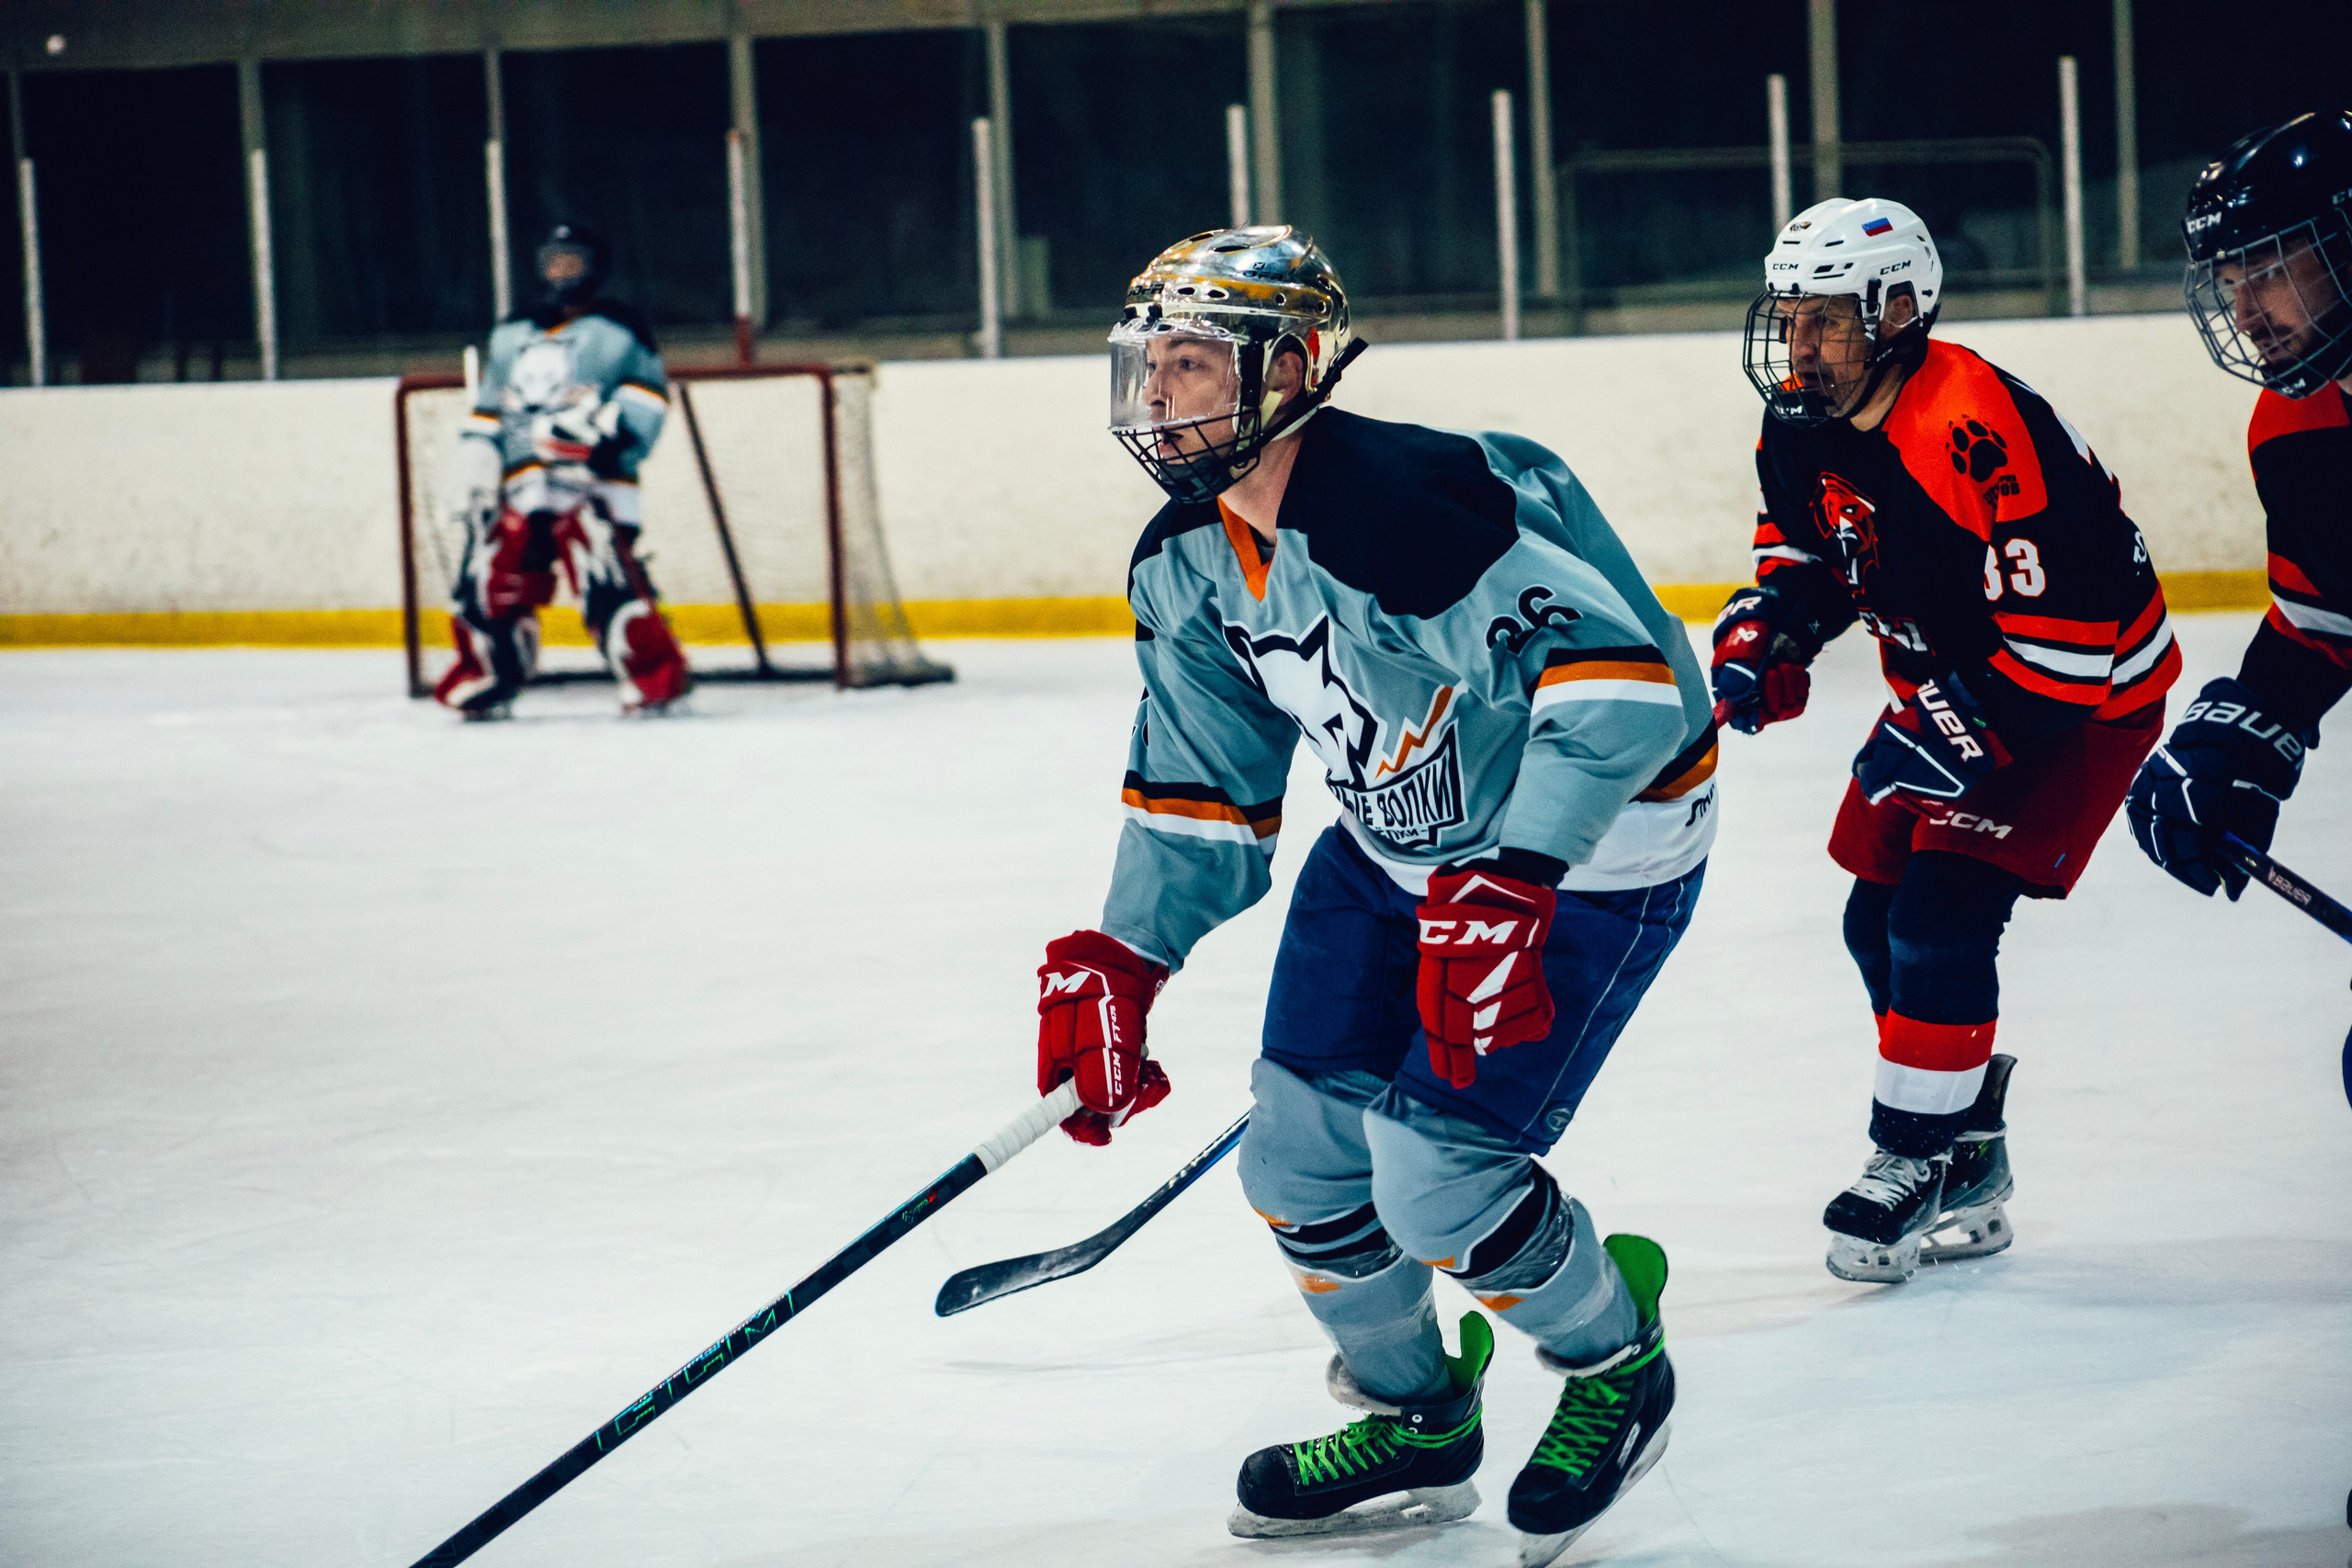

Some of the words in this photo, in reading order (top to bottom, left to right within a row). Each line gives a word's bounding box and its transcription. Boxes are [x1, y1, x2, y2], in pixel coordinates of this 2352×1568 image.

[2187, 211, 2222, 233] CCM
[1772, 263, 1799, 271] CCM
[1880, 260, 1911, 276] CCM
[1917, 679, 1984, 762] UER
[2178, 700, 2306, 771] BAUE
[1112, 1051, 1123, 1096] CCM
